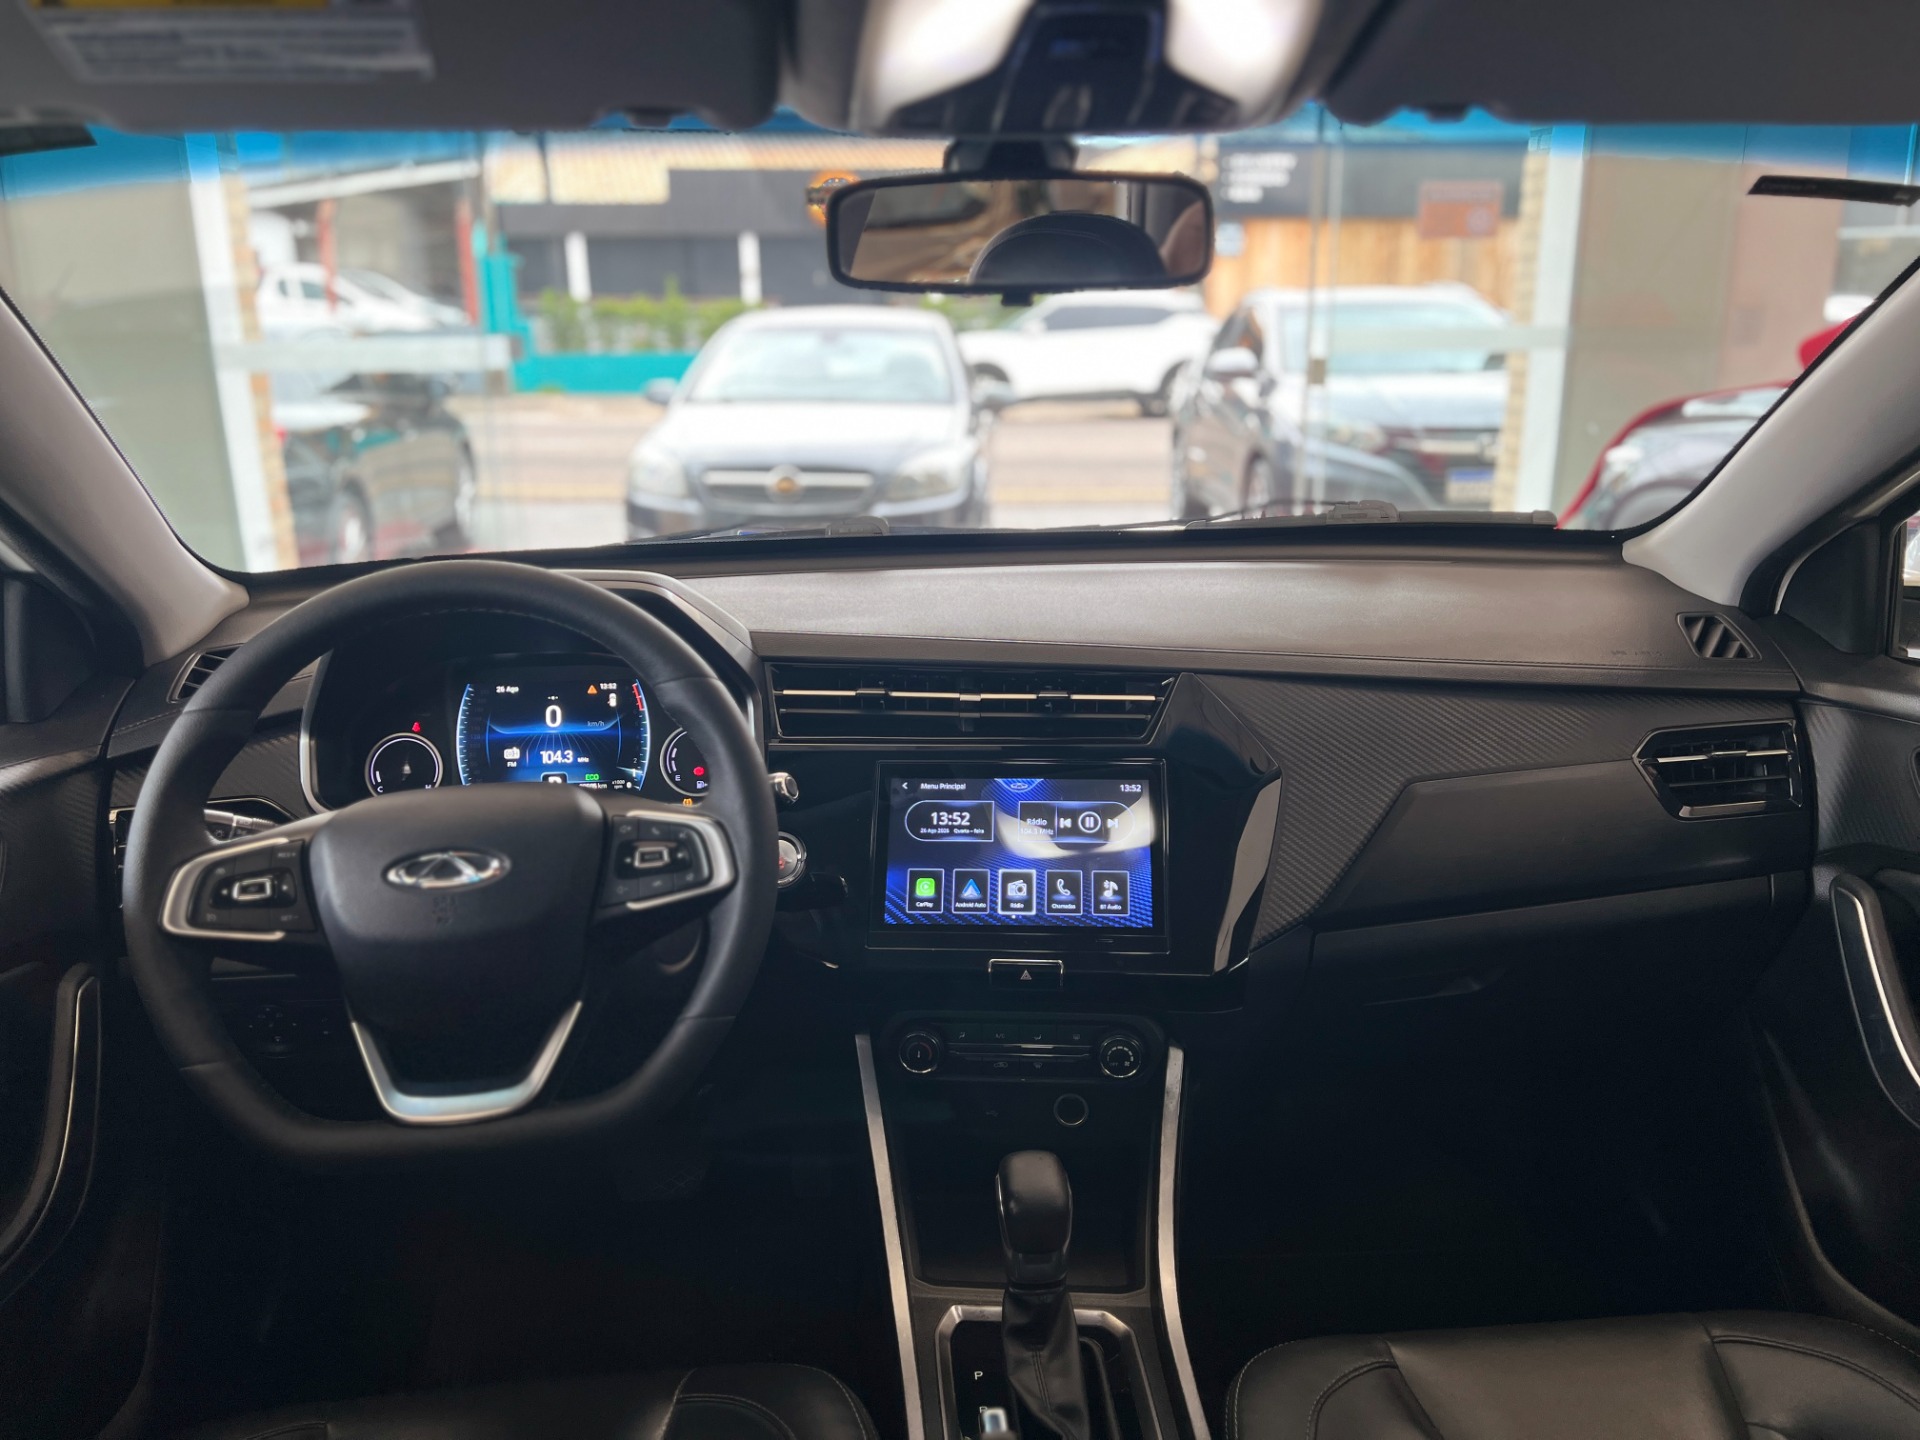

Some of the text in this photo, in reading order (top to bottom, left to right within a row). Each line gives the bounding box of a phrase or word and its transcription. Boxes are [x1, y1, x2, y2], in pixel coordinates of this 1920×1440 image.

[545, 705, 562, 727] 0
[540, 750, 573, 764] 104.3
[585, 773, 600, 781] ECO
[940, 783, 966, 791] Principal
[1120, 784, 1142, 792] 13:52
[931, 811, 970, 826] 13:52
[1027, 818, 1048, 826] Rádio
[974, 1371, 984, 1380] P
